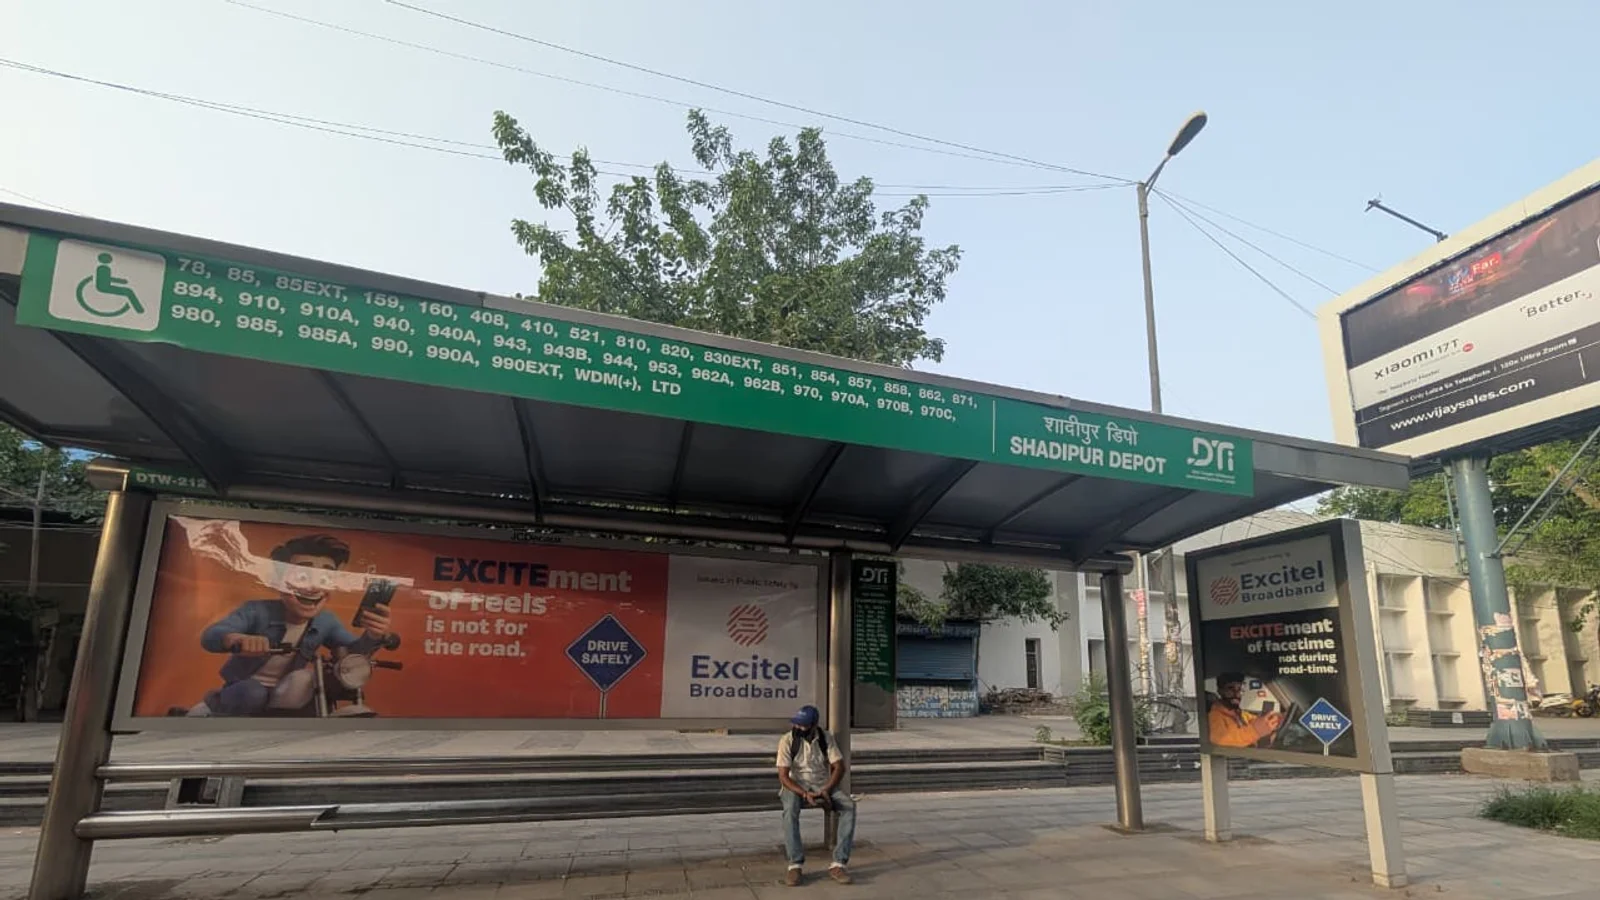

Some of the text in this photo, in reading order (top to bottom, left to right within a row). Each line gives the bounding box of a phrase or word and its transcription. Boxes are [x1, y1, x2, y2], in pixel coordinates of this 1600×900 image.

[180, 258, 978, 409] 78, 85, 85EXT, 159, 160, 408, 410, 521, 810, 820, 830EXT, 851, 854, 857, 858, 862, 871,
[171, 304, 680, 395] 980, 985, 985A, 990, 990A, 990EXT, WDM(+), LTD
[173, 281, 956, 422] 894, 910, 910A, 940, 940A, 943, 943B, 944, 953, 962A, 962B, 970, 970A, 970B, 970C,
[1374, 349, 1435, 380] xiaomi
[1390, 377, 1536, 432] www.vijaysales.com
[1043, 415, 1138, 446] शादीपुर डिपो
[1010, 436, 1166, 475] SHADIPUR DEPOT
[433, 556, 632, 592] EXCITEment
[1241, 560, 1324, 591] Excitel
[1242, 581, 1325, 603] Broadband
[471, 593, 547, 614] reels
[426, 616, 528, 635] is not for
[1230, 619, 1334, 640] EXCITEment
[424, 639, 526, 657] the road.
[587, 640, 629, 652] DRIVE
[1248, 637, 1335, 653] of facetime
[581, 654, 632, 665] SAFELY
[692, 654, 799, 681] Excitel
[1279, 652, 1337, 664] not during
[1279, 665, 1338, 675] road-time.
[690, 683, 798, 699] Broadband
[1309, 721, 1342, 730] SAFELY
[1311, 713, 1338, 722] DRIVE
